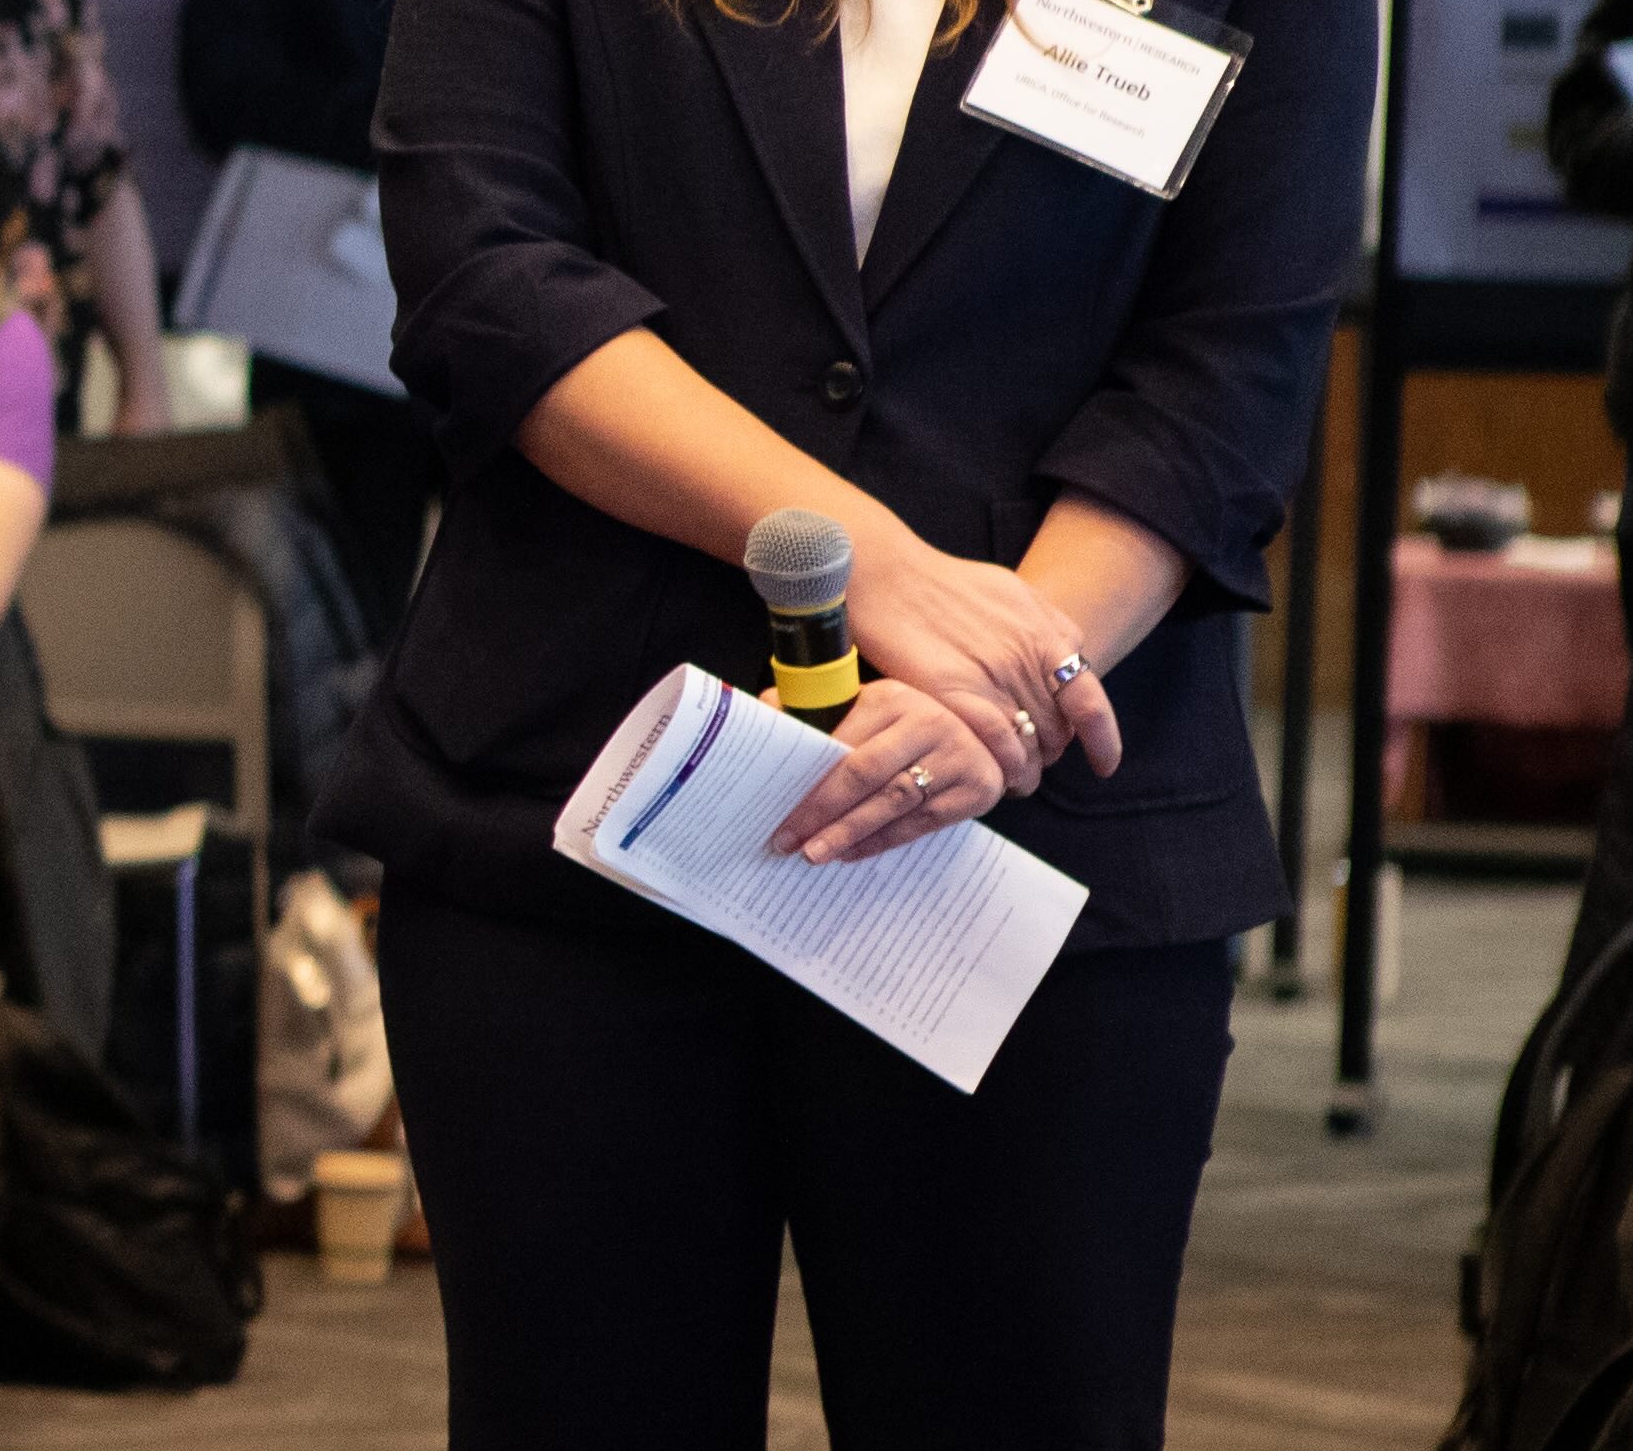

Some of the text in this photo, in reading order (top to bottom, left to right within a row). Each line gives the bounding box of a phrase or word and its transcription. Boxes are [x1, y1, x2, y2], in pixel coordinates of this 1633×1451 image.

[1044, 45, 1152, 102] Allie Trueb
[581, 713, 672, 838] Northwestern
